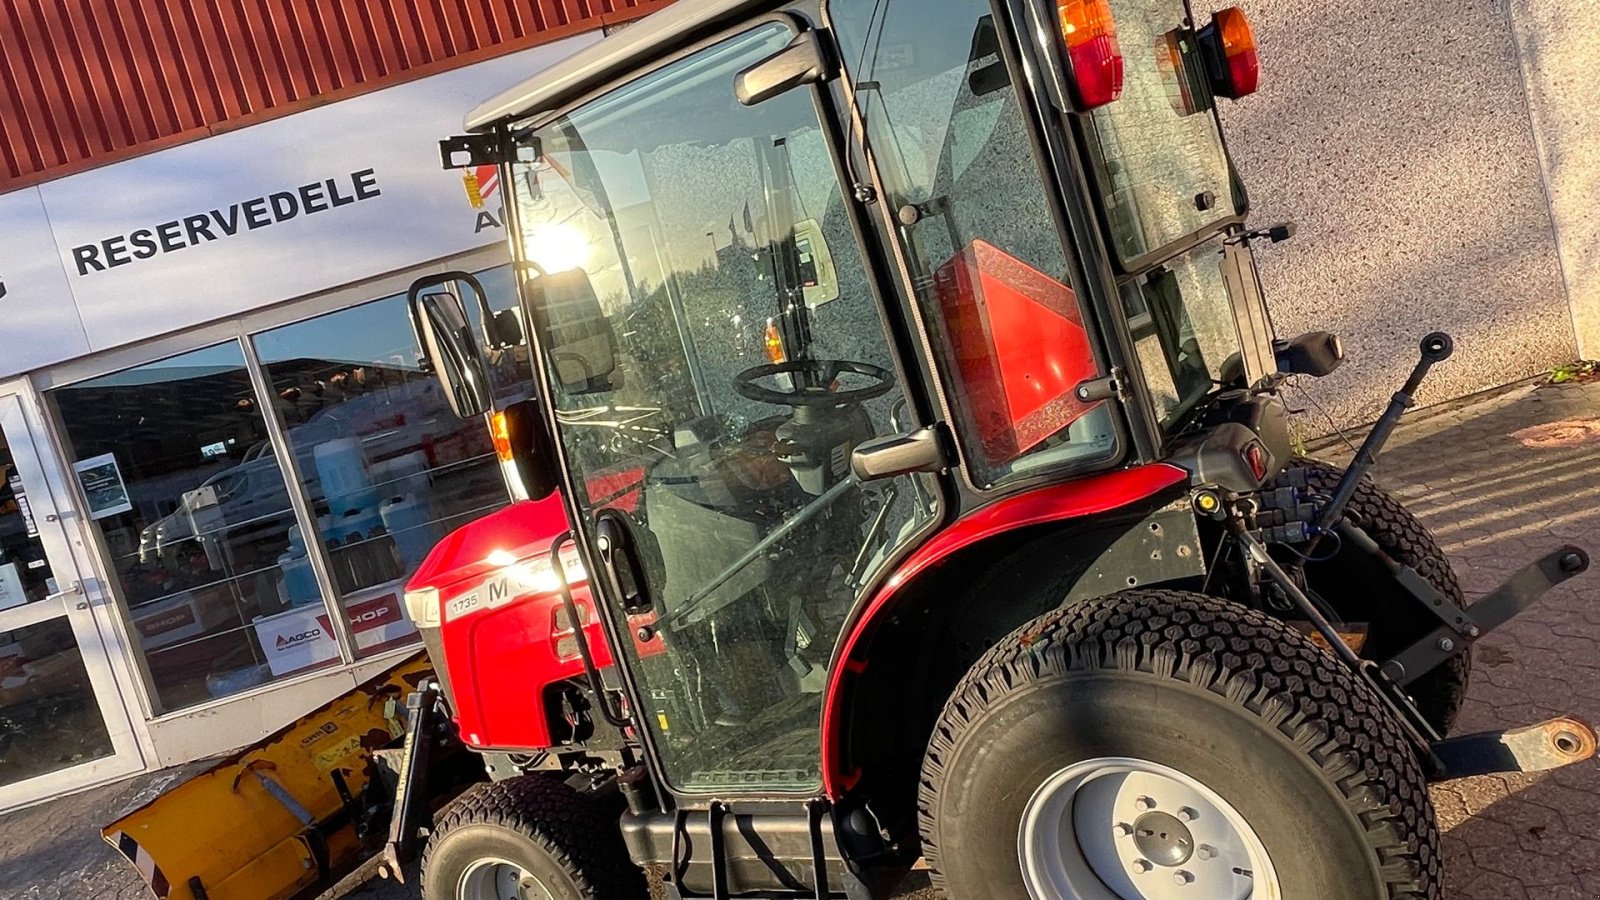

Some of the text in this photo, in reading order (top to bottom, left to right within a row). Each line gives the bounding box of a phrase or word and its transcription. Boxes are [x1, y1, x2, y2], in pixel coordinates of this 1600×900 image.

[72, 168, 381, 276] RESERVEDELE
[453, 578, 508, 613] 1735 M
[350, 606, 390, 625] HOP
[288, 628, 321, 642] AGCO
